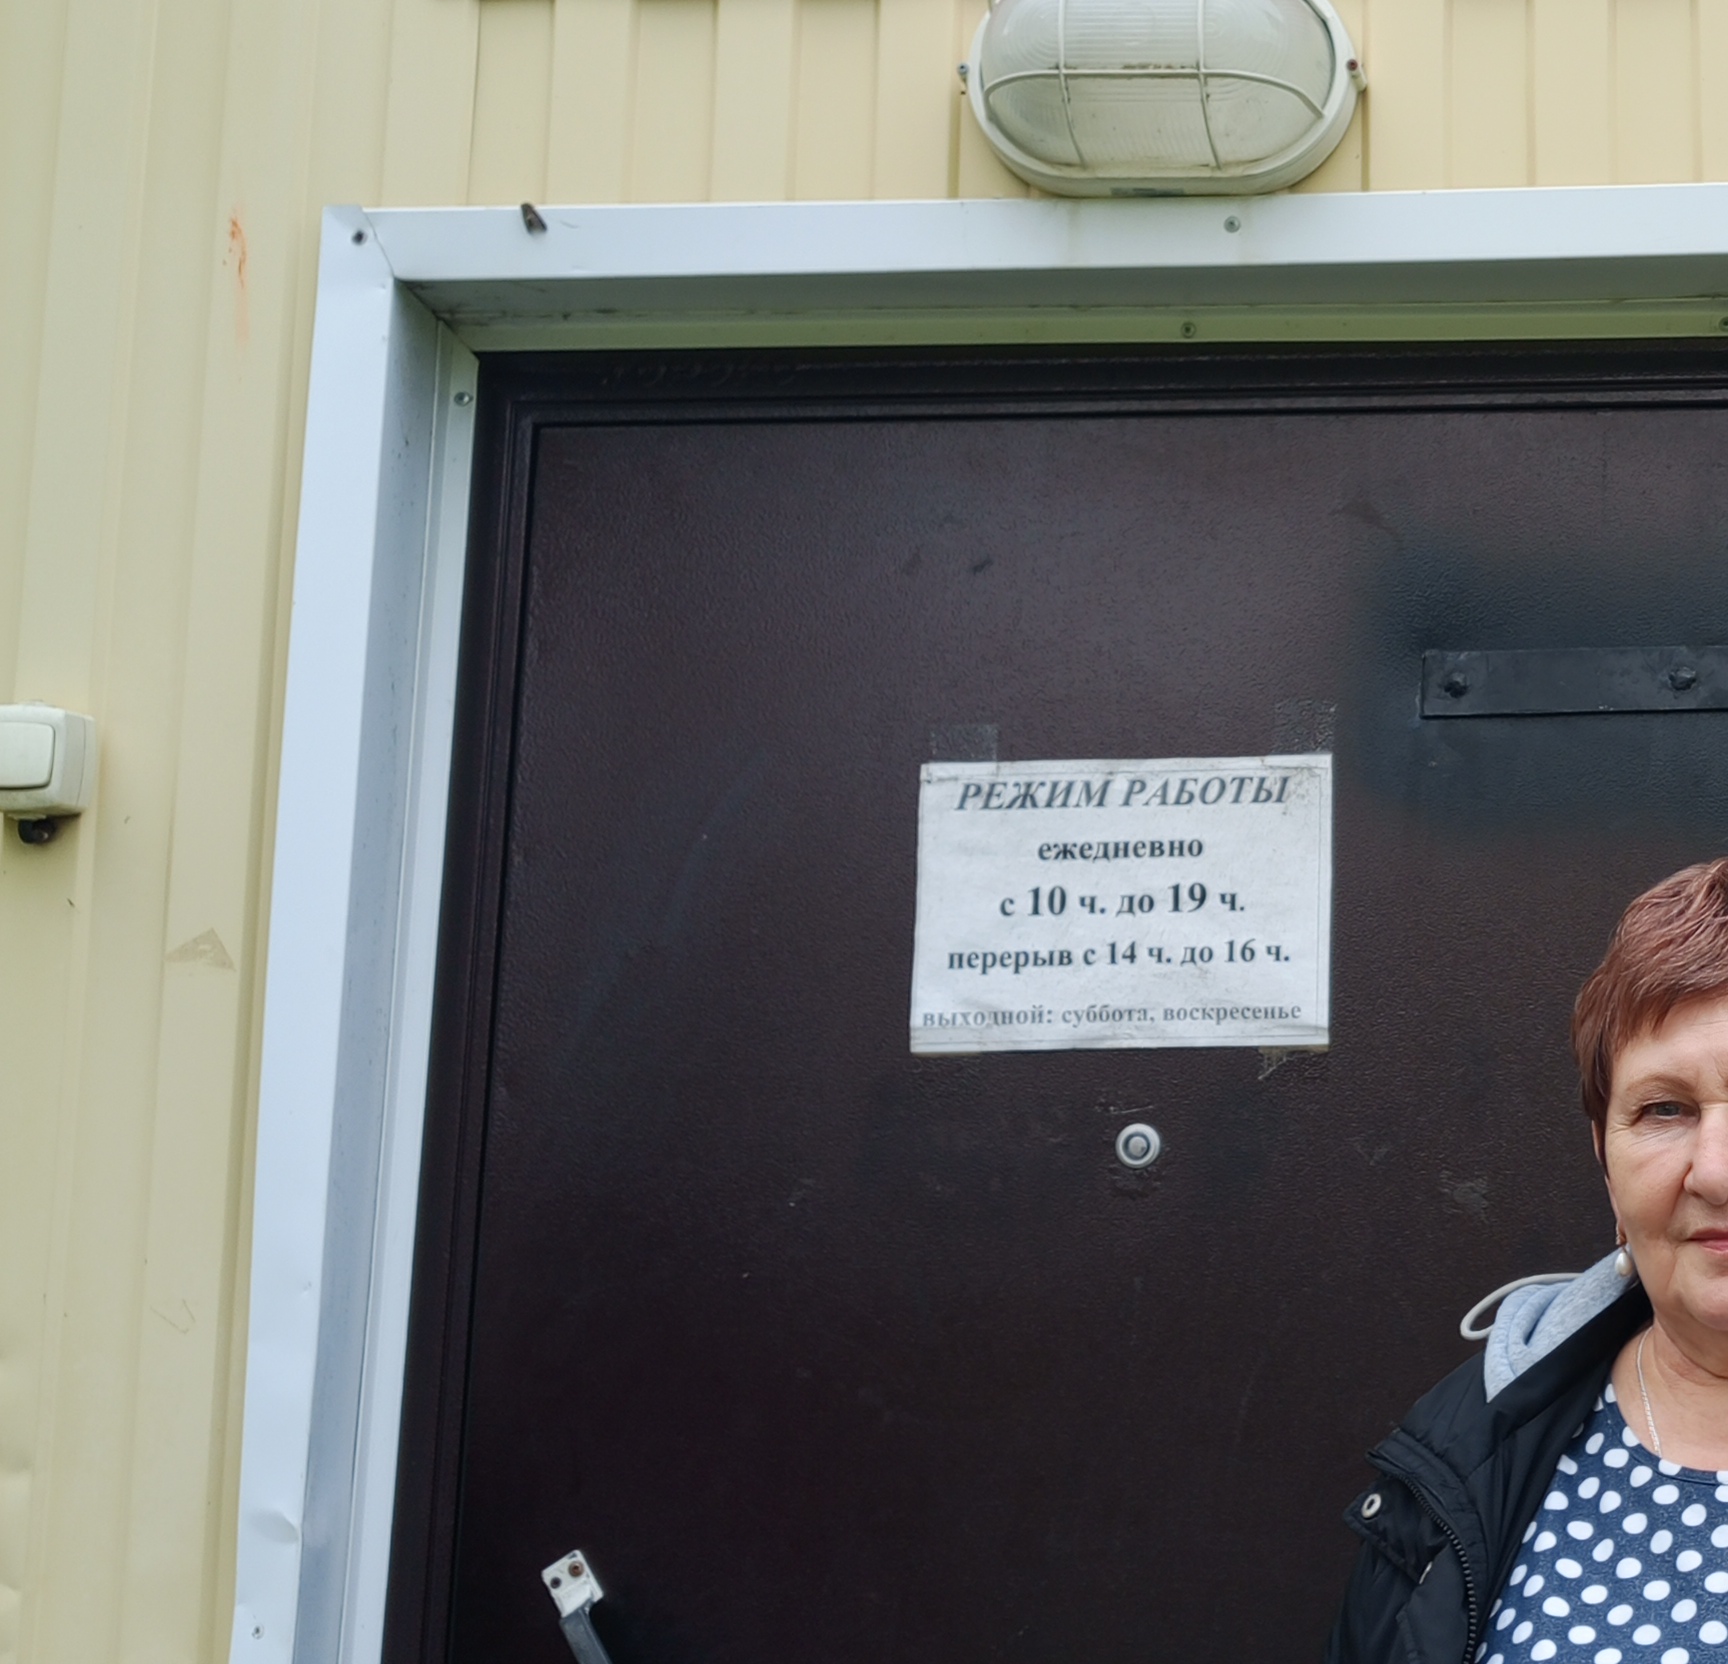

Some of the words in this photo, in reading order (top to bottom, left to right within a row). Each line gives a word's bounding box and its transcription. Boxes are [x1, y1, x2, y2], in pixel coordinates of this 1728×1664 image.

[955, 779, 1112, 810] РЕЖИМ
[1120, 776, 1291, 806] РАБОТЫ
[1038, 839, 1203, 863] ежедневно
[1000, 898, 1014, 917] с
[1028, 886, 1067, 916] 10
[1079, 896, 1106, 914] ч.
[1116, 894, 1155, 917] до
[1169, 883, 1207, 912] 19
[1220, 893, 1244, 911] ч.
[948, 950, 1073, 975] перерыв
[1083, 950, 1096, 966] с
[1108, 941, 1137, 964] 14
[1148, 947, 1171, 963] ч.
[1180, 947, 1213, 966] до
[1226, 939, 1255, 962] 16
[1266, 946, 1289, 961] ч.
[921, 1005, 1053, 1027] выходной:
[1062, 1004, 1155, 1028] суббота,
[1163, 1004, 1301, 1026] воскресенье
